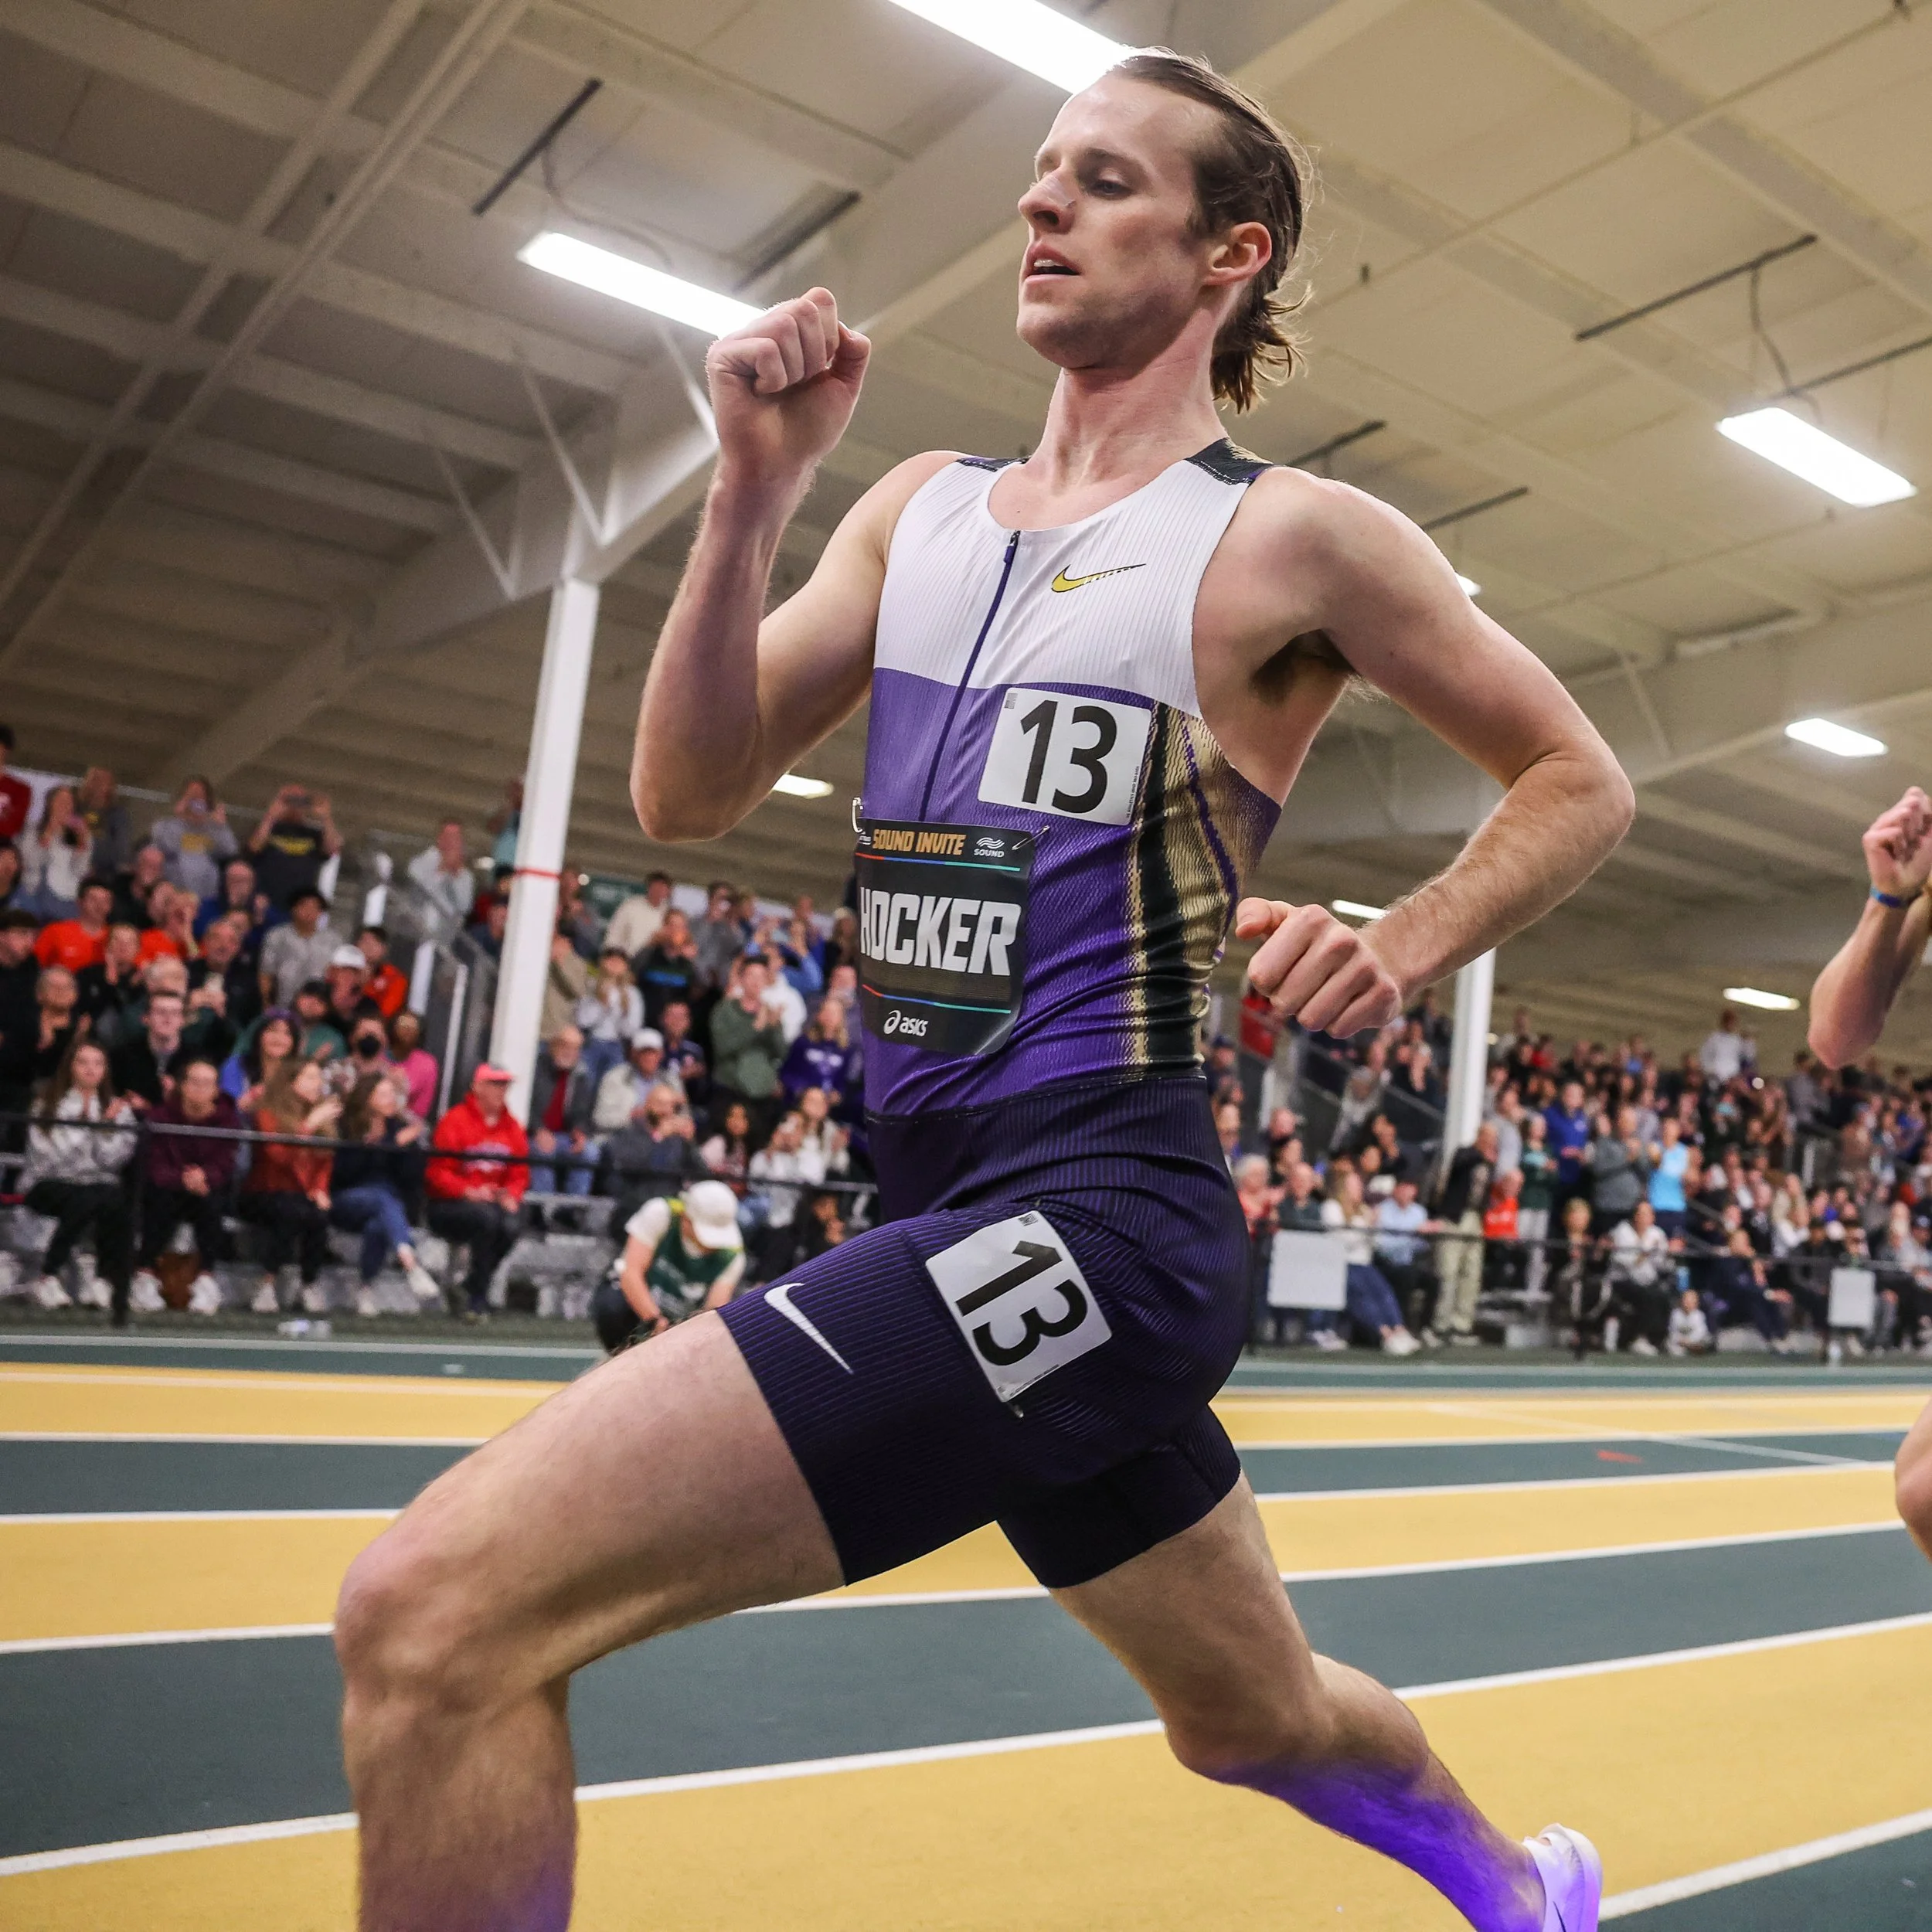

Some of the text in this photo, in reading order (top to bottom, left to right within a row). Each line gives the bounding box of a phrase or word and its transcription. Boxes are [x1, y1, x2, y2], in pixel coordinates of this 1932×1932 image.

[1020, 699, 1117, 814] 13
[872, 829, 915, 852] SOUND
[915, 832, 967, 855] INVITE
[974, 849, 1005, 858] SOUND
[860, 886, 1022, 976] HOCKER
[955, 1240, 1087, 1366] 13
